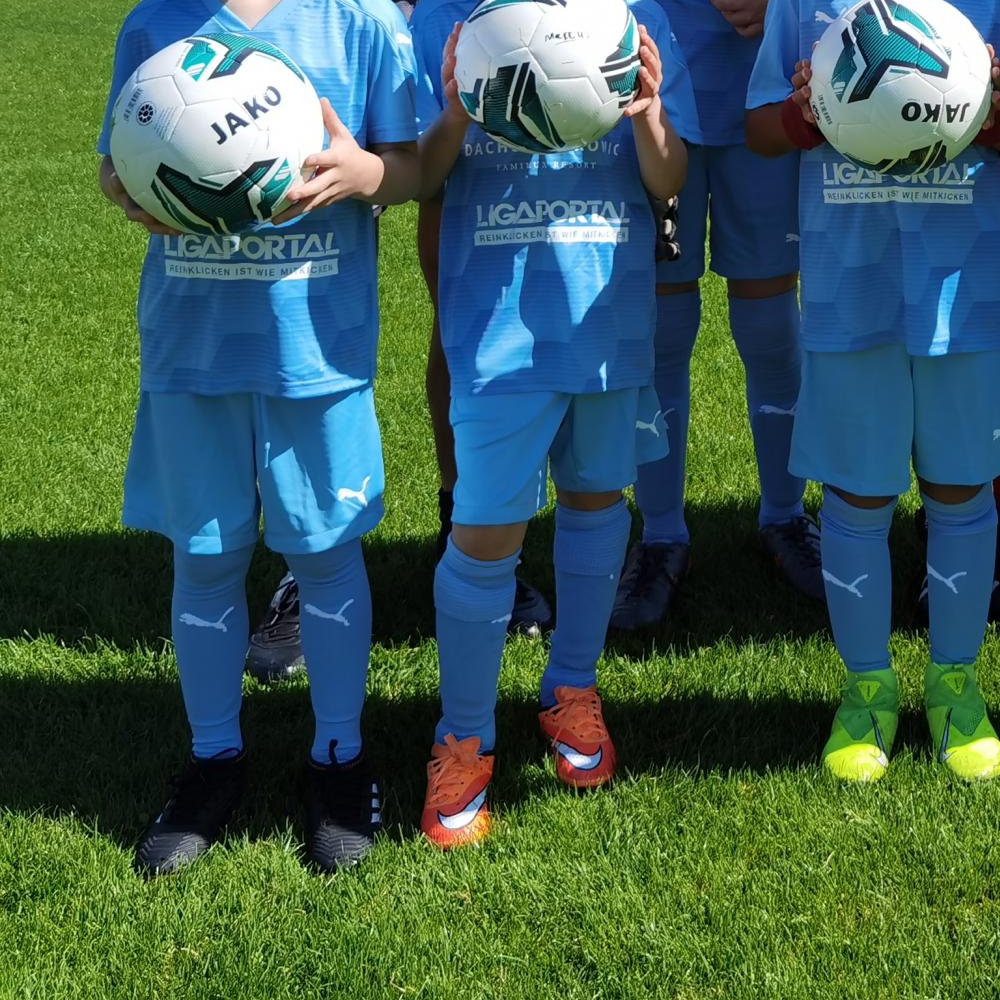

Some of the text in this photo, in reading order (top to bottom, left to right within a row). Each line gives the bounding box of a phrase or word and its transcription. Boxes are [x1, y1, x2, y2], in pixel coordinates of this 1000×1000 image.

[210, 85, 282, 146] JAKO
[901, 101, 971, 124] JAKO
[827, 190, 883, 200] REINKLICKEN
[902, 191, 920, 201] WIE
[922, 191, 969, 200] MITKICKEN
[476, 199, 630, 227] LIGAPORTAL
[164, 232, 340, 260] LIGAPORTAL
[235, 267, 252, 276] IST
[256, 267, 275, 276] WIE
